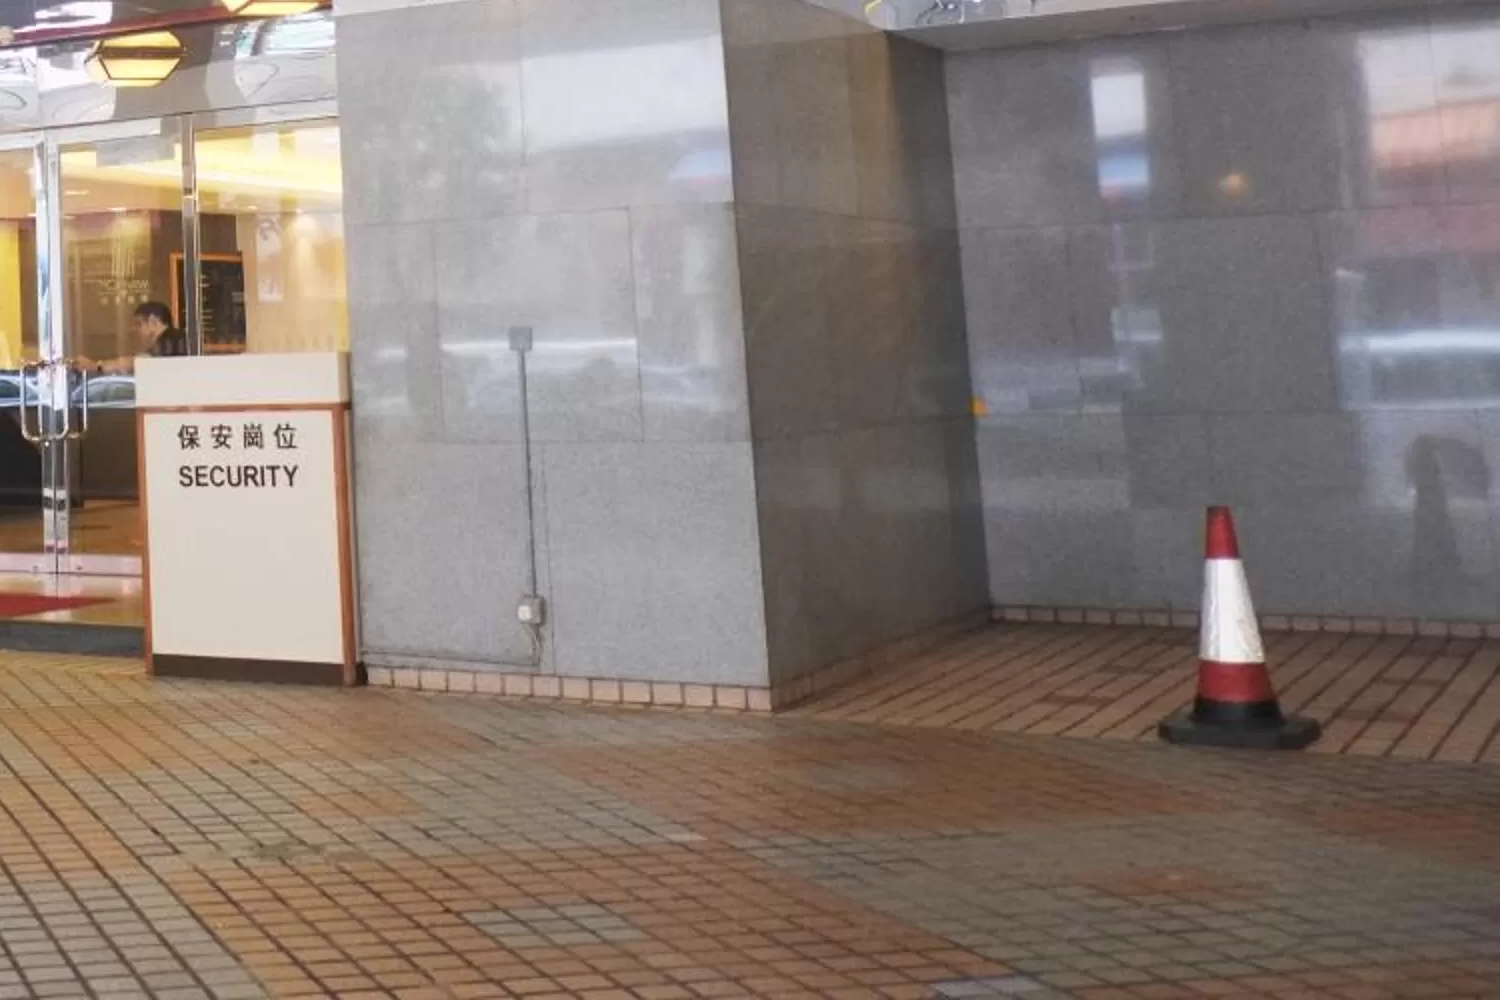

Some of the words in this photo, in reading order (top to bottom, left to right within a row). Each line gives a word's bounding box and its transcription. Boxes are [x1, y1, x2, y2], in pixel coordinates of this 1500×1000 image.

[177, 422, 298, 449] 保安崗位
[179, 465, 298, 487] SECURITY
